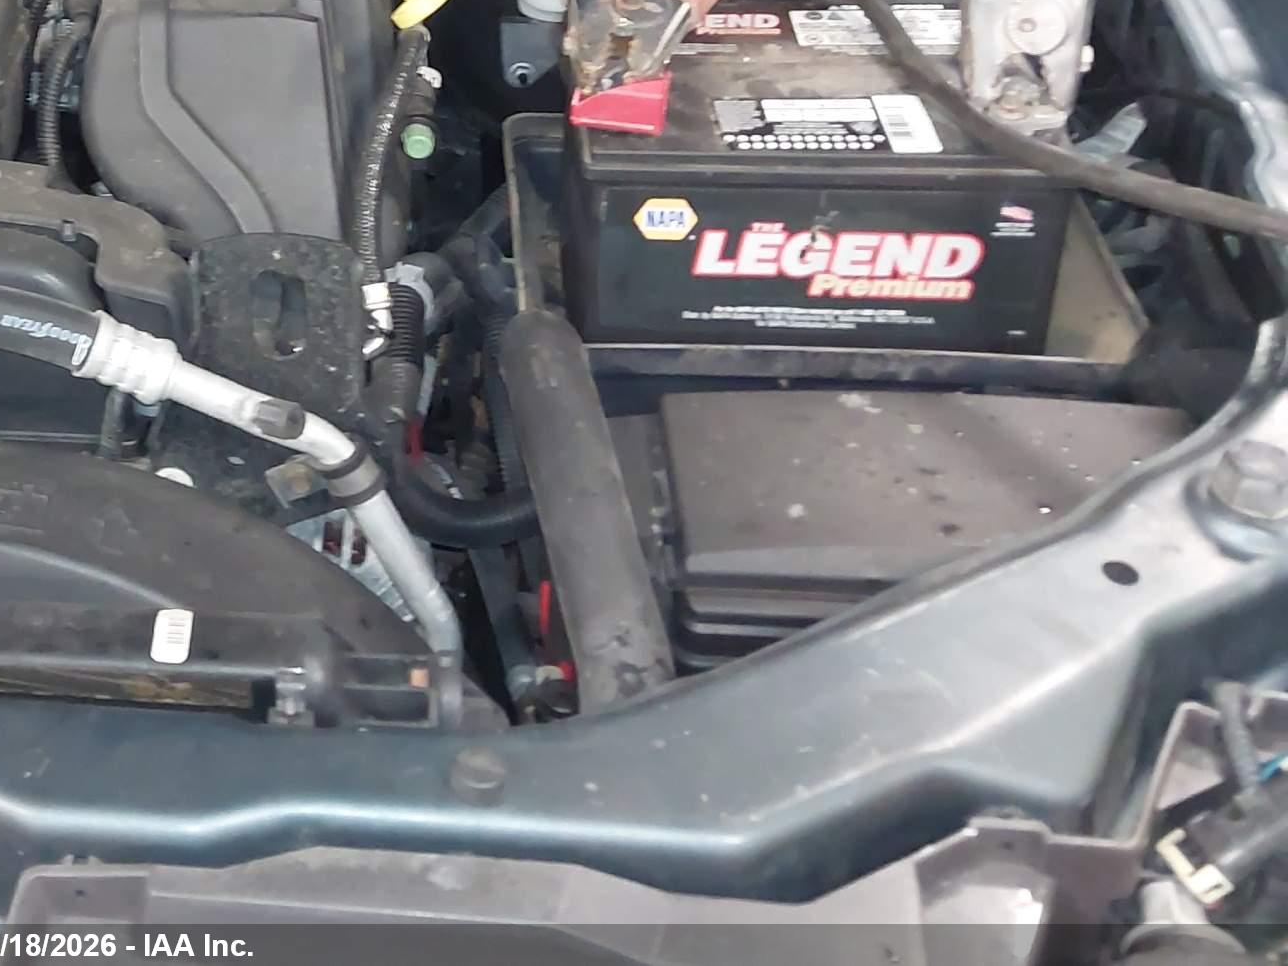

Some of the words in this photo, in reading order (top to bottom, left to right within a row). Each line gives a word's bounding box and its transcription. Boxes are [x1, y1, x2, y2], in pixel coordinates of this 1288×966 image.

[646, 210, 686, 228] NAPA
[694, 231, 983, 278] LEGEND
[810, 274, 973, 299] Premium
